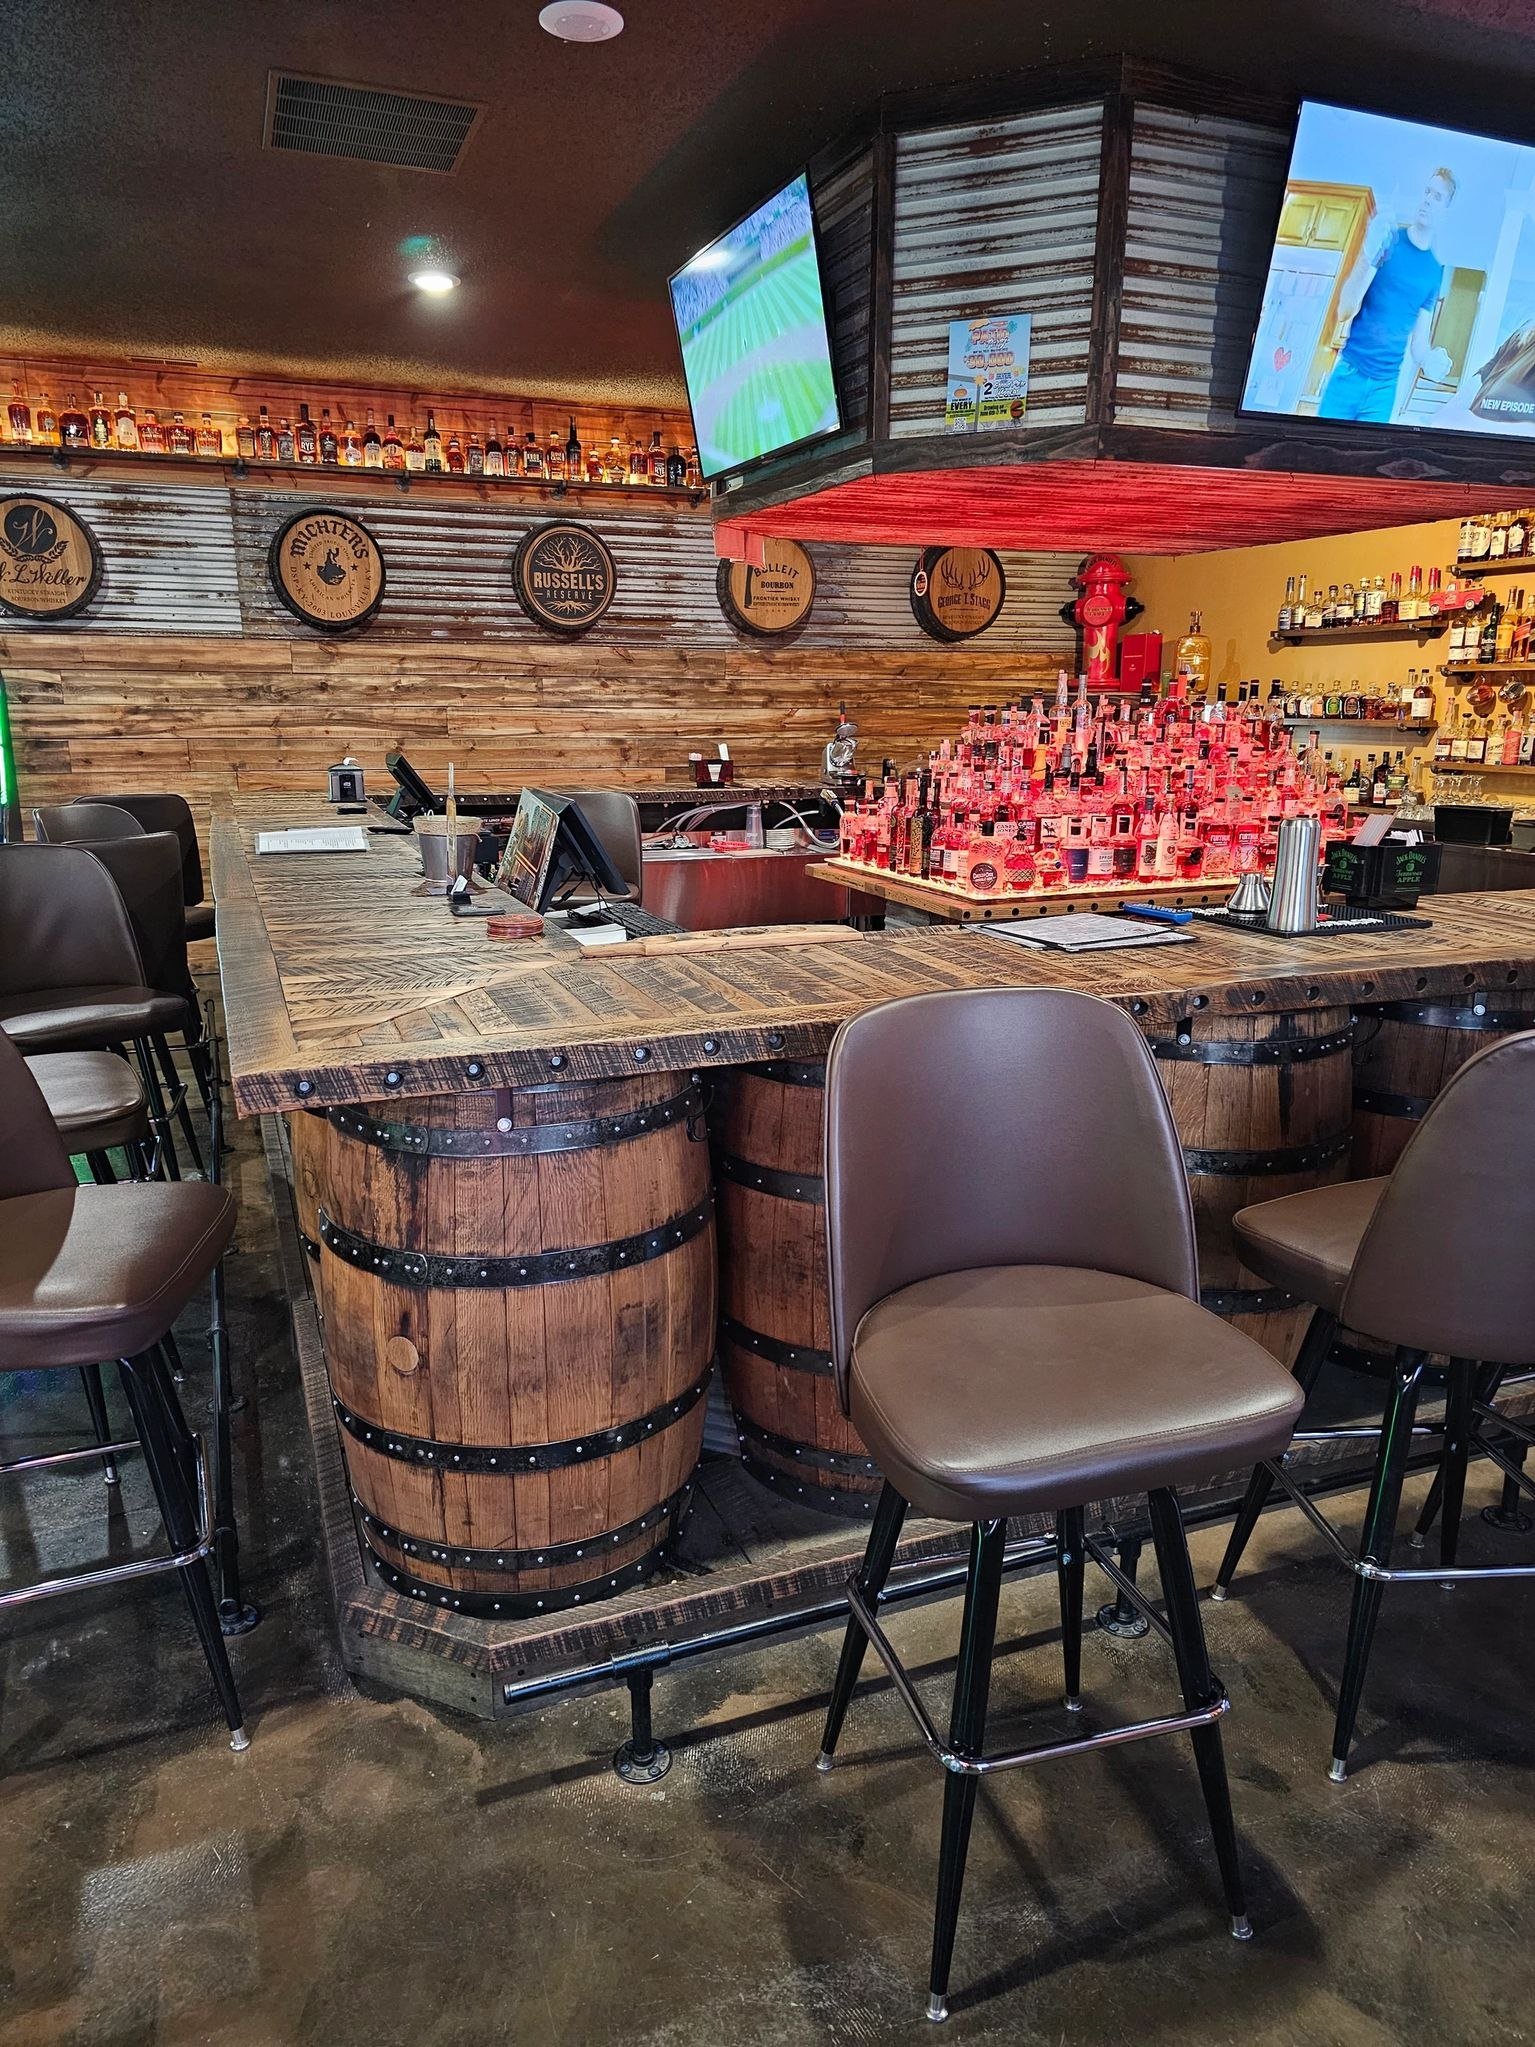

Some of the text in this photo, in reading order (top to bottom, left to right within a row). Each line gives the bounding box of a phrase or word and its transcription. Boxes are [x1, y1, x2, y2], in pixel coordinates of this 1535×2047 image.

[951, 401, 972, 411] EVERY
[1480, 399, 1535, 414] NEW EPISODE
[301, 441, 314, 451] RYE
[654, 466, 665, 476] RYE
[289, 519, 370, 559] MICHTER'S
[533, 571, 605, 591] RUSSELL'S
[760, 581, 794, 590] BOURBON
[546, 589, 593, 601] RESERVE
[937, 594, 960, 609] GEORGE
[969, 593, 991, 610] STAGG
